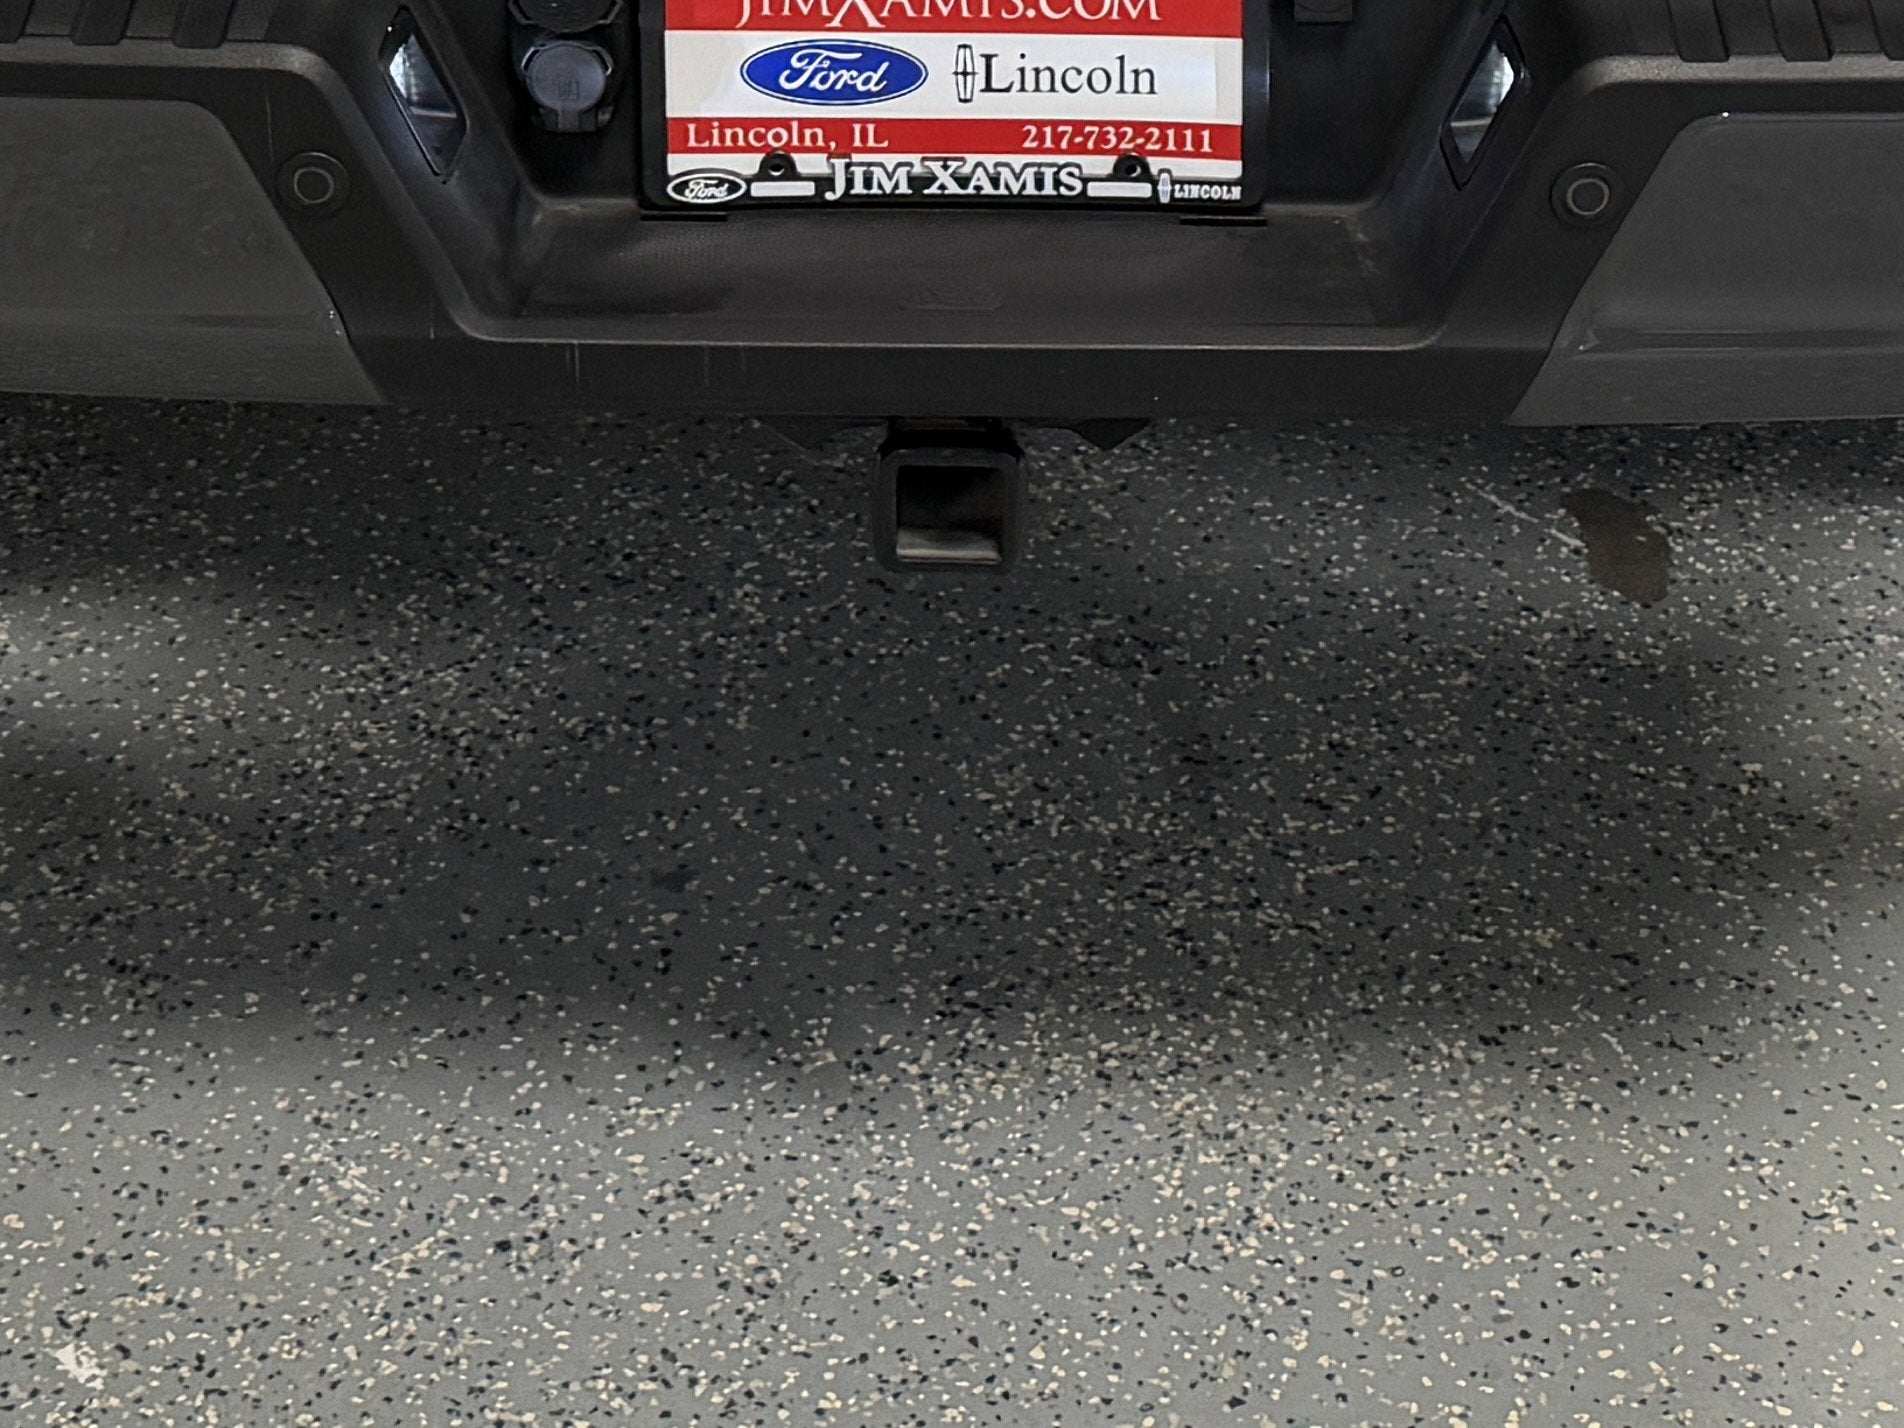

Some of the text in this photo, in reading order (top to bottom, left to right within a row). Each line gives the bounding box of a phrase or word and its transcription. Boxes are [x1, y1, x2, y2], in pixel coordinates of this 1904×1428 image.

[779, 49, 1156, 94] Ford Lincoln
[687, 122, 1213, 153] Lincoln, IL 217-732-2111
[684, 179, 729, 200] Ford
[825, 159, 1082, 200] JIM XAMIS
[1174, 184, 1242, 200] LINCOLN
